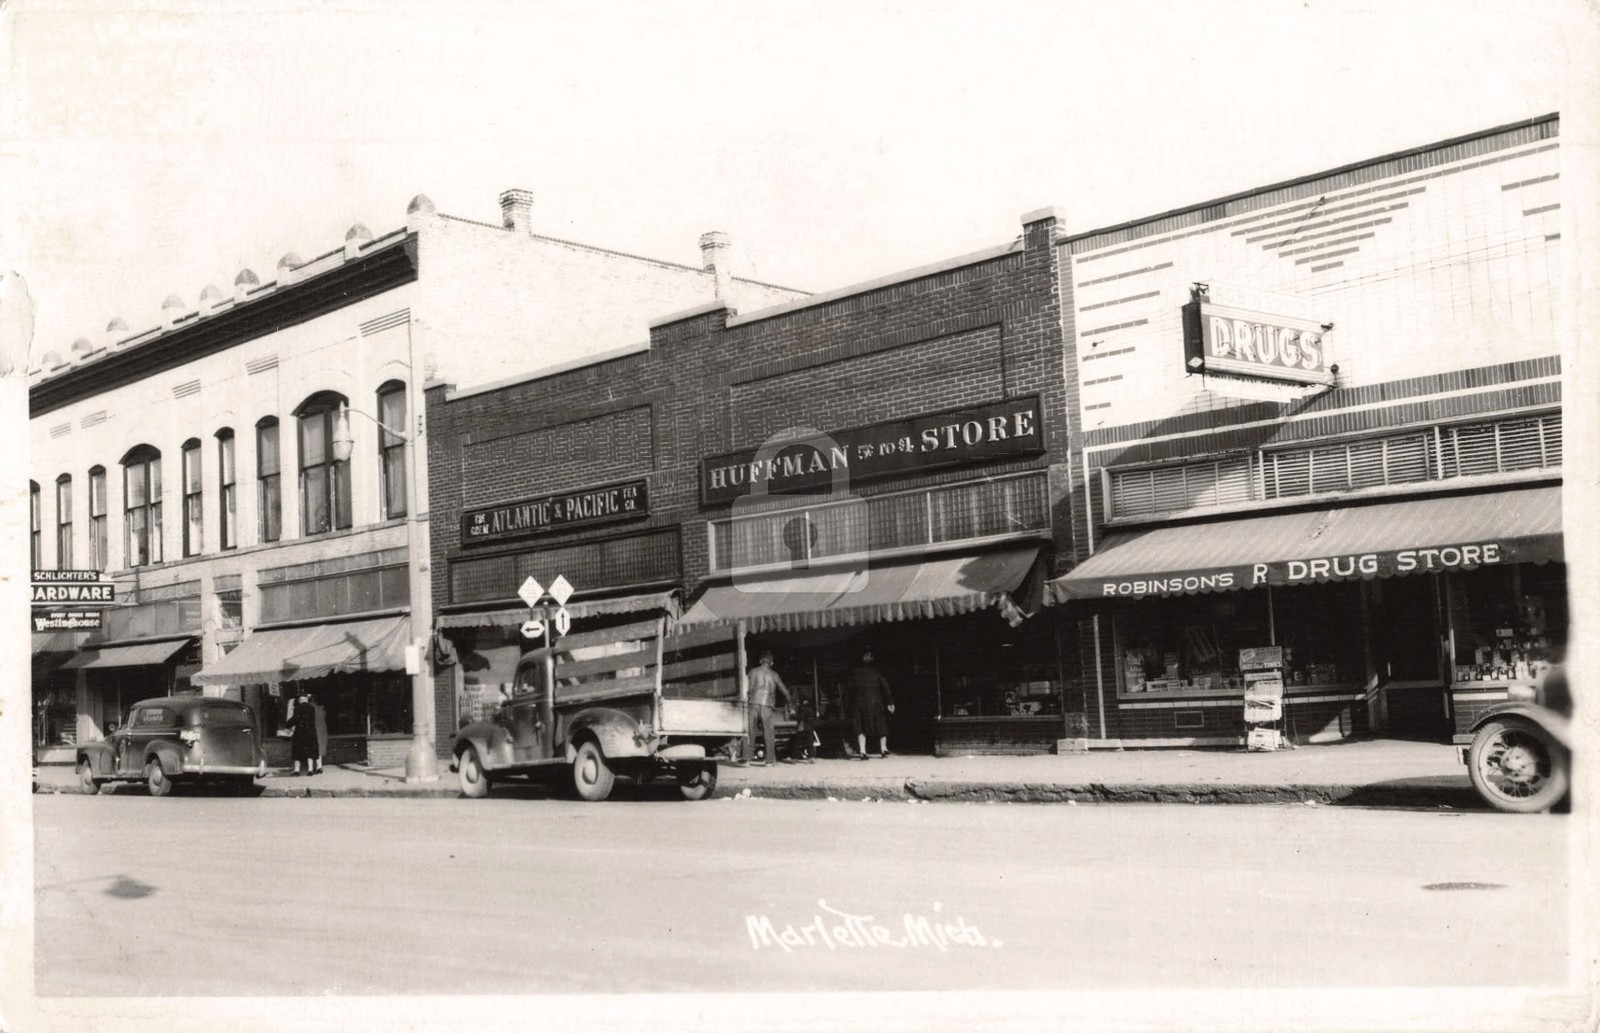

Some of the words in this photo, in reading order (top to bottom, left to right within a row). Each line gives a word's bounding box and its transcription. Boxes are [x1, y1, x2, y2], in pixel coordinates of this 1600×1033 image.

[1209, 316, 1323, 371] DRUGS
[708, 444, 850, 490] HUFFMAN
[920, 410, 1035, 453] STORE
[492, 502, 550, 533] ATLANTIC
[554, 503, 563, 519] &
[566, 490, 619, 521] PACIFIC
[34, 571, 97, 581] SCHLICHTER'S
[1102, 573, 1234, 596] ROBINSON'S
[1287, 554, 1378, 580] DRUG
[1396, 544, 1500, 571] STORE
[35, 618, 101, 631] Westinghouse
